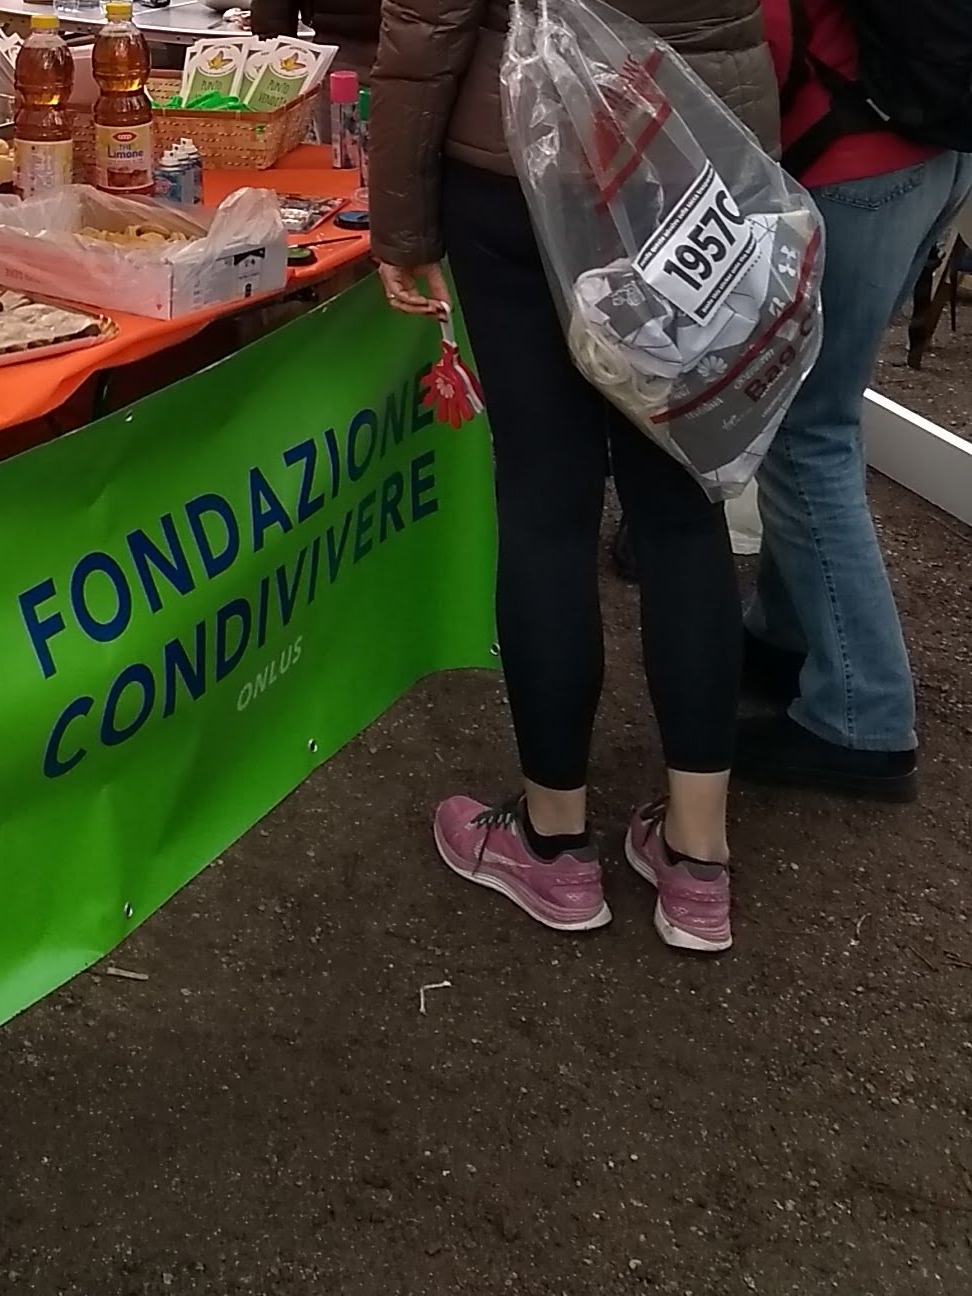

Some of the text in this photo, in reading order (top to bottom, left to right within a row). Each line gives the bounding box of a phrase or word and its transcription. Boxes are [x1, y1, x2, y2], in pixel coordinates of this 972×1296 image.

[107, 144, 144, 159] Limone
[744, 346, 796, 402] Bag
[18, 362, 433, 680] FONDAZIONE
[42, 450, 439, 778] CONDIVIVERE
[237, 635, 303, 712] ONLUS
